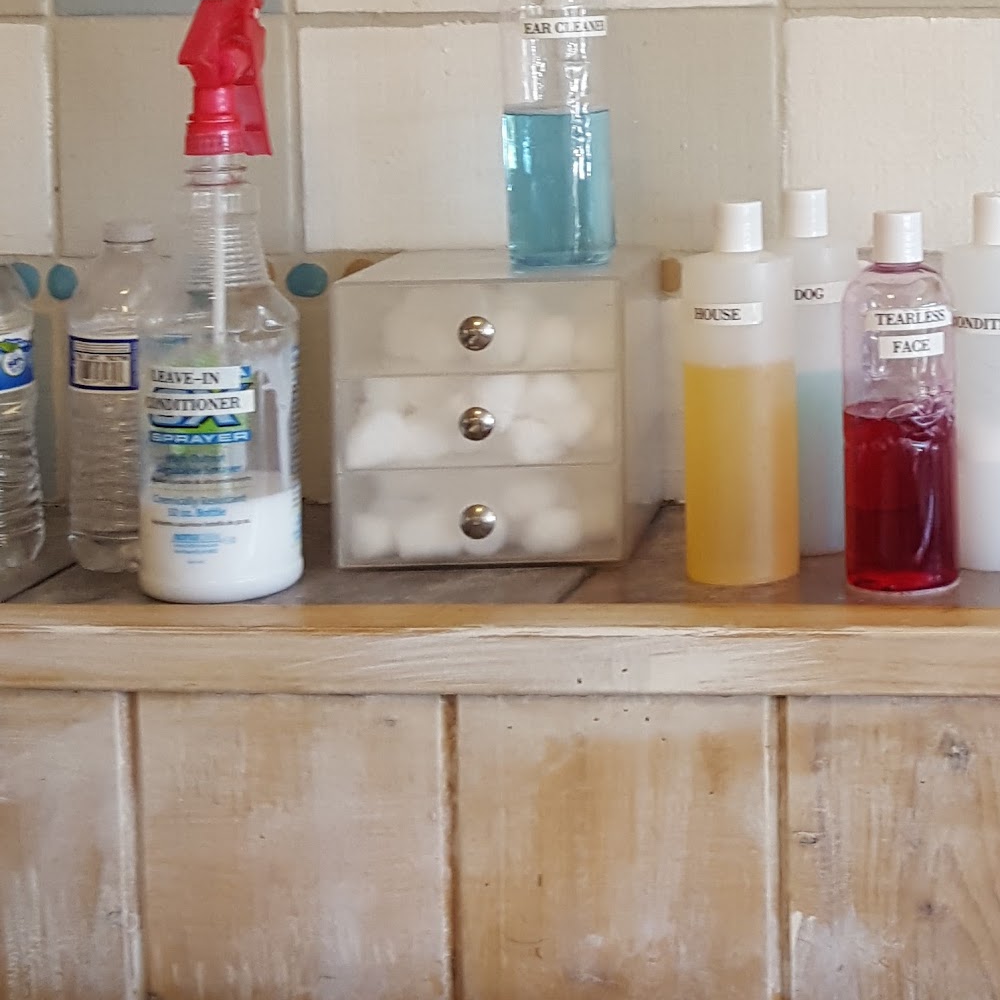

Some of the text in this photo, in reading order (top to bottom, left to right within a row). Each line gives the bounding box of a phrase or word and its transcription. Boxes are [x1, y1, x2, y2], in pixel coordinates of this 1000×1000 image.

[523, 22, 552, 34] EAR
[794, 288, 824, 300] DOG
[693, 307, 742, 320] HOUSE
[874, 309, 946, 325] TEARLESS
[892, 339, 930, 353] FACE
[151, 431, 249, 443] SPRAYER
